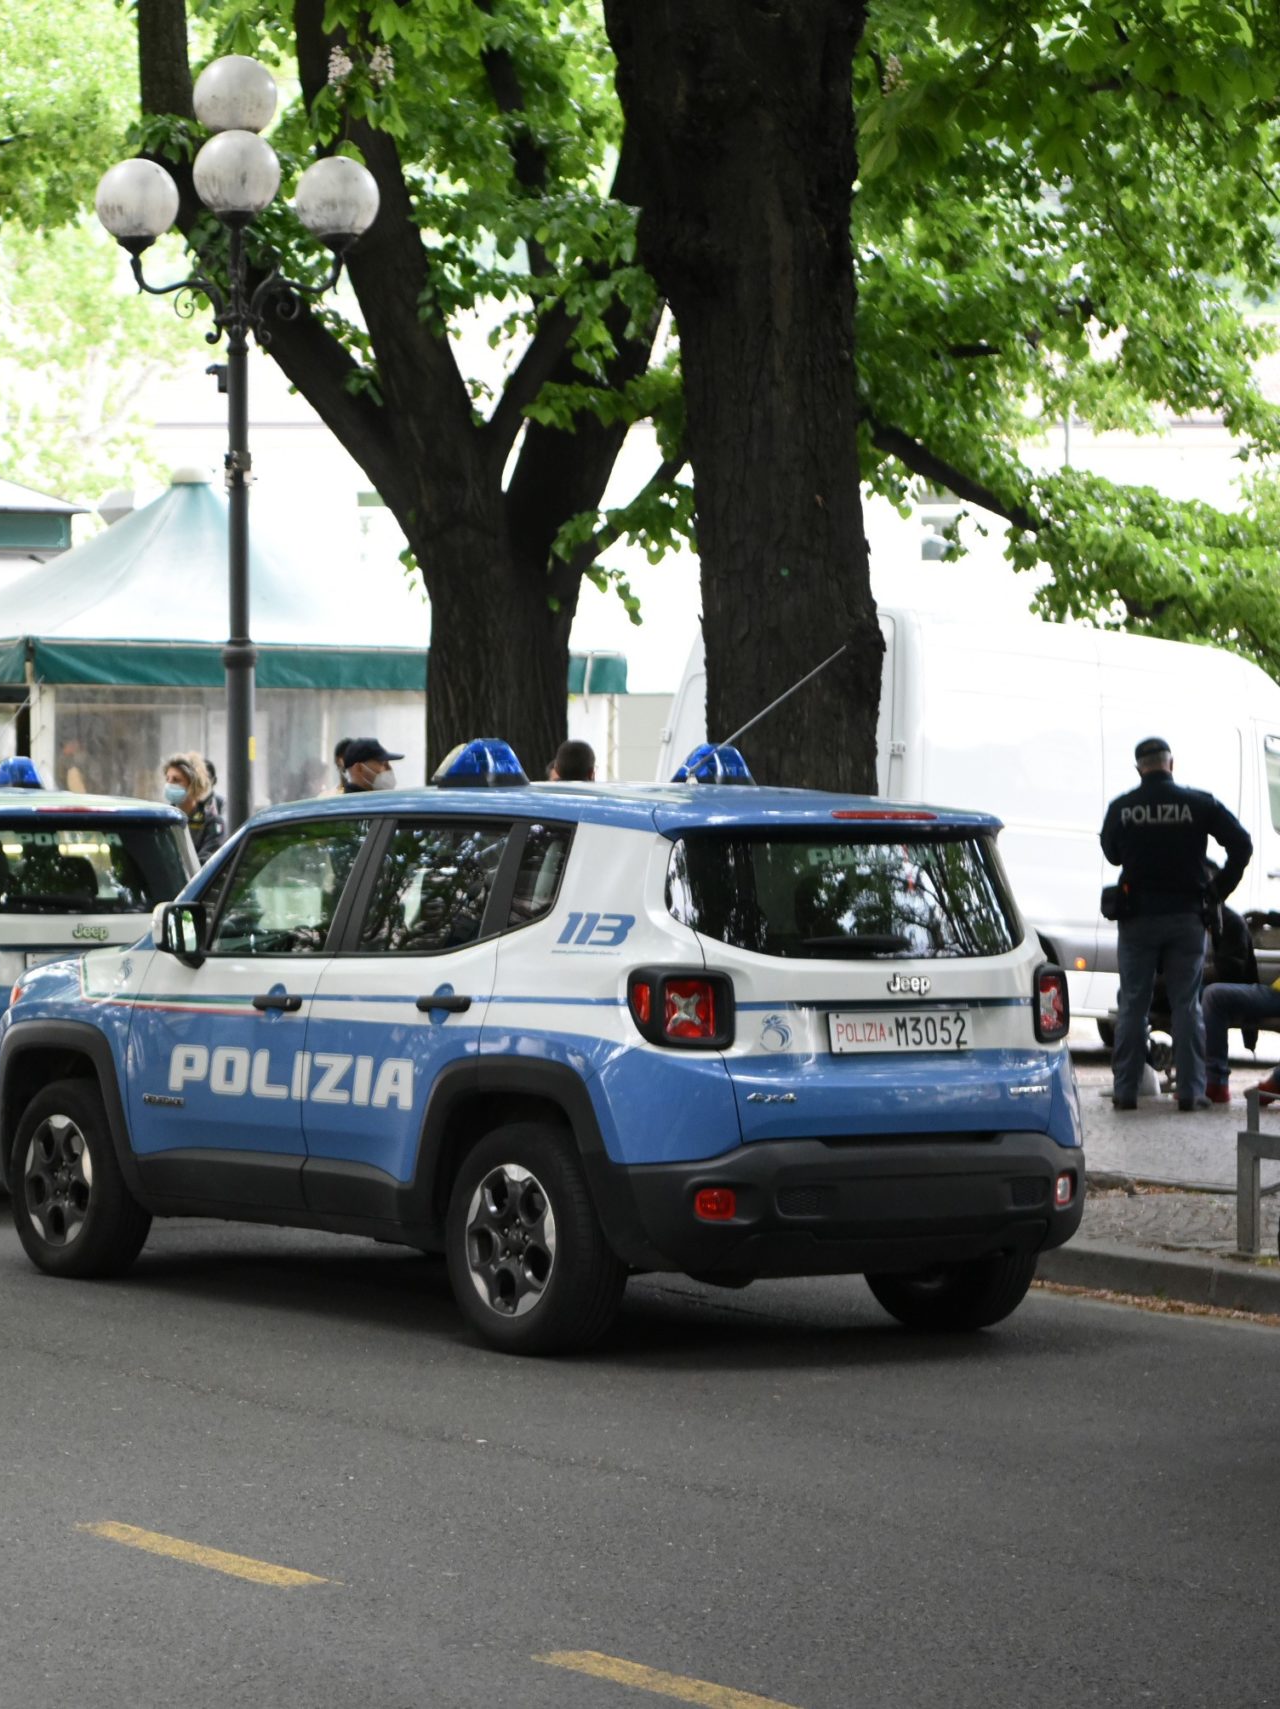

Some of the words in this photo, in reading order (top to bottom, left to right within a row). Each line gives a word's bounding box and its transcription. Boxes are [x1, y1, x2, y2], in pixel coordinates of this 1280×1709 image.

[1121, 803, 1193, 828] POLIZIA
[72, 923, 109, 941] Jeep
[556, 911, 636, 947] 113
[887, 973, 931, 995] Jeep
[836, 1023, 887, 1043] POLIZIA
[894, 1016, 968, 1048] M3052
[168, 1044, 414, 1111] POLIZIA
